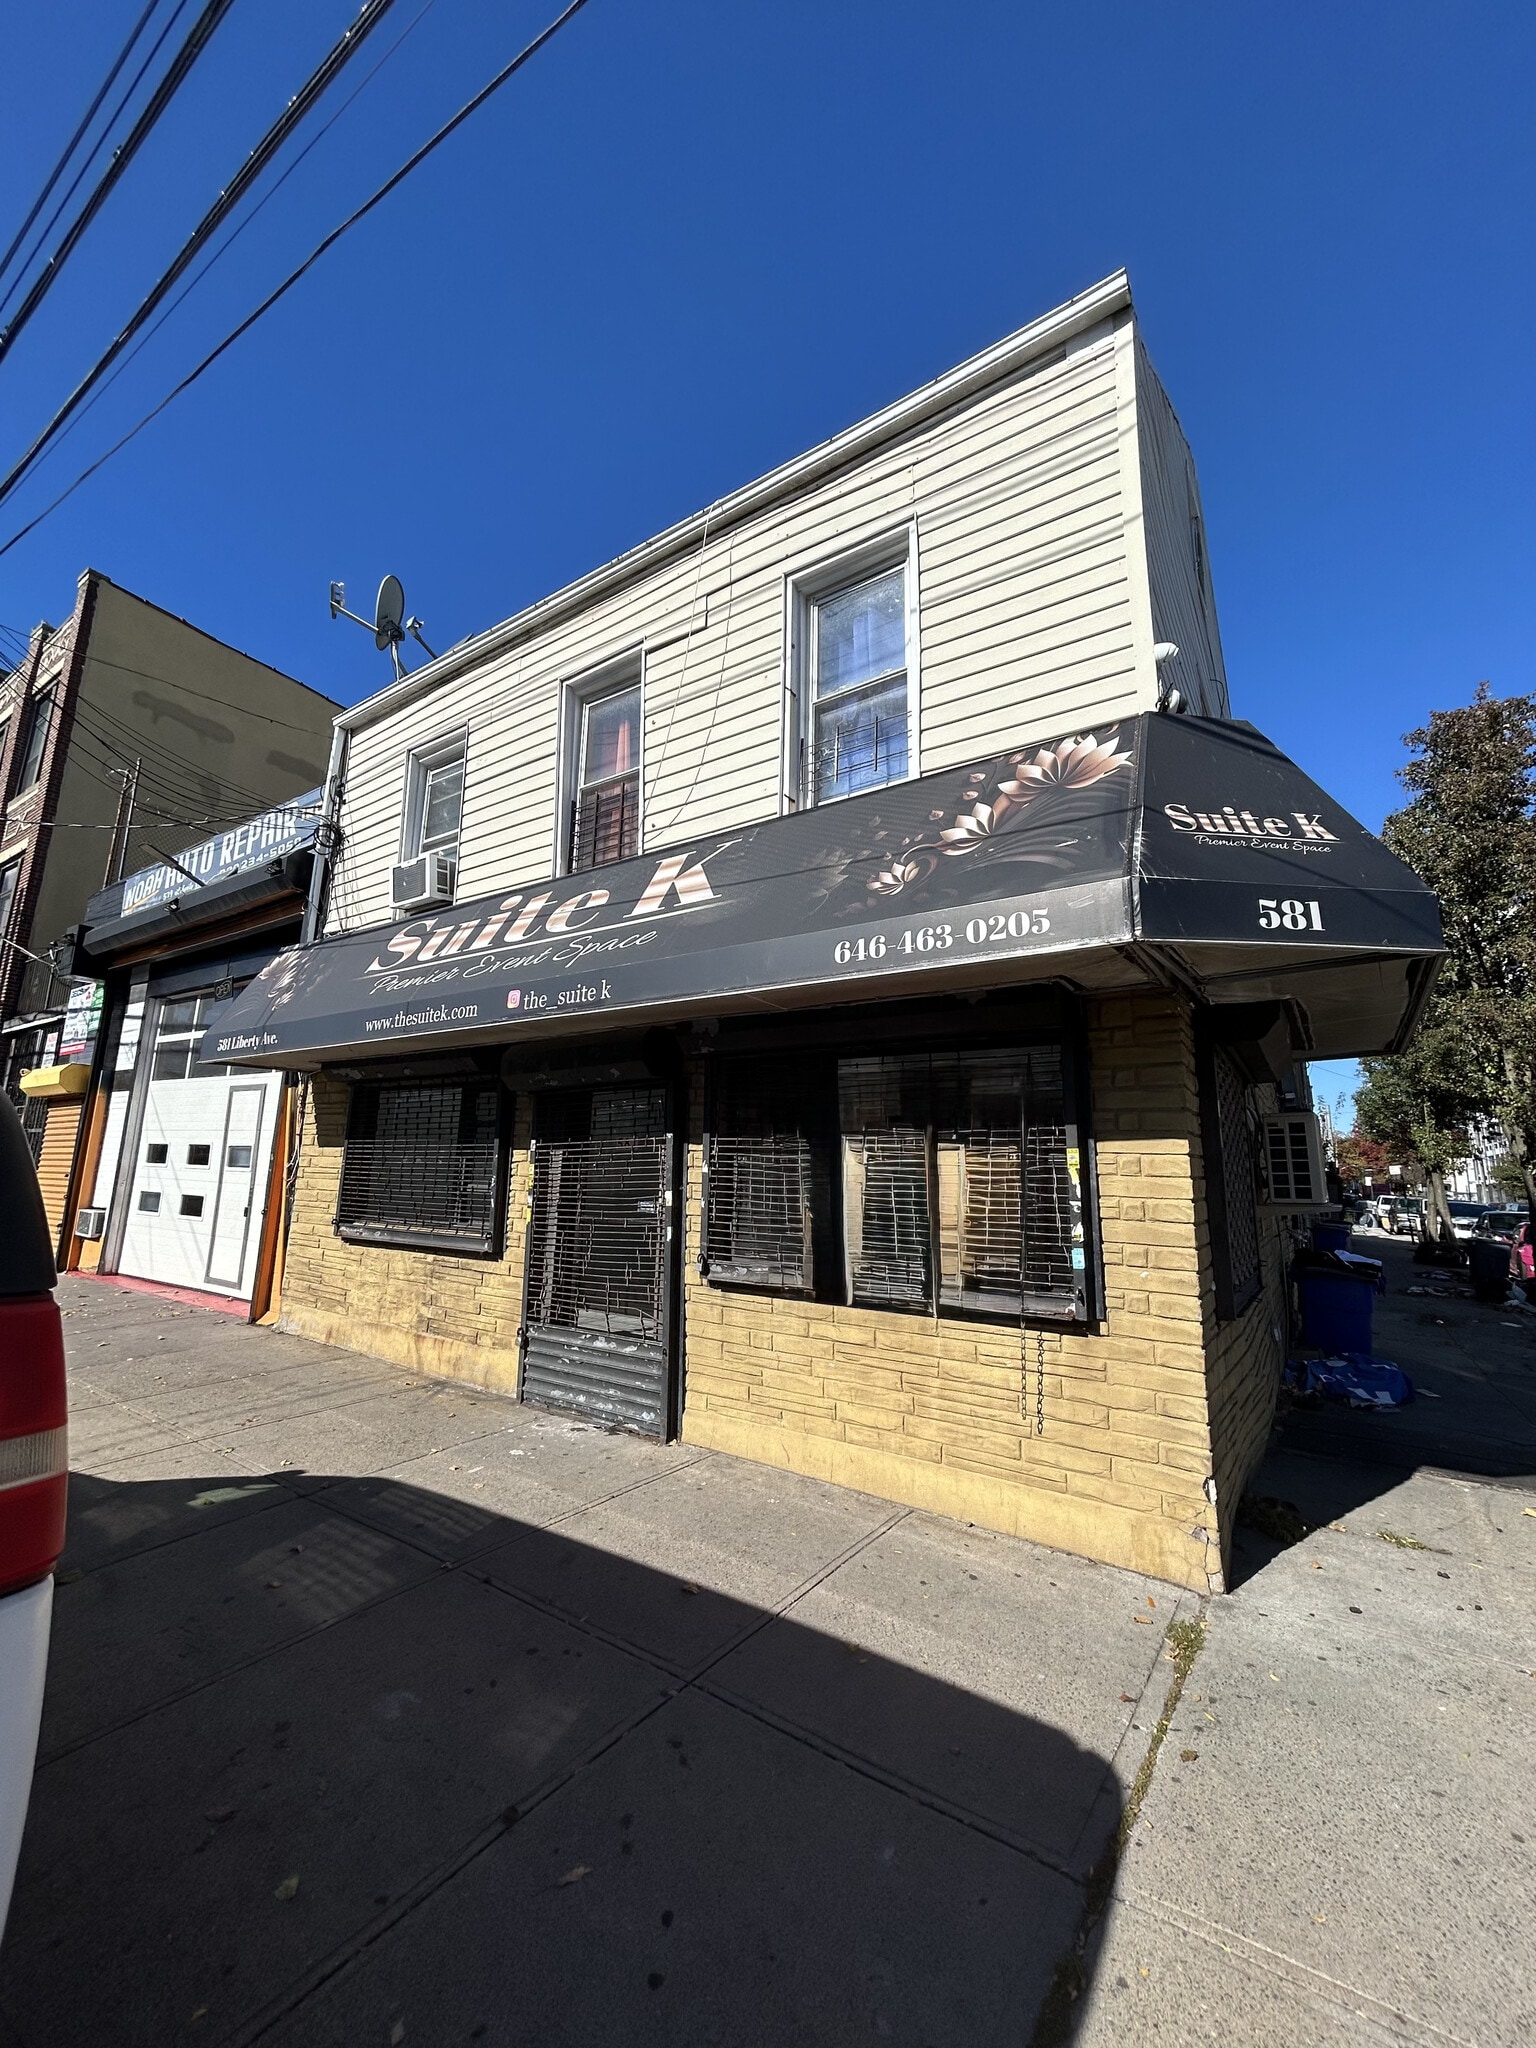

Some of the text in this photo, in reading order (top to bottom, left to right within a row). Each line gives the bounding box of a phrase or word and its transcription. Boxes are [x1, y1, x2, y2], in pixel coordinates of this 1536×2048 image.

[1164, 803, 1340, 841] Suite K
[125, 801, 299, 909] NOAH AUTO REPAIR
[1194, 834, 1332, 855] Premier Event Space
[365, 838, 743, 973] Suite K
[1258, 899, 1326, 931] 581
[834, 908, 1051, 964] 646-463-0205
[369, 930, 658, 995] Premier Event Space
[365, 1003, 478, 1032] www.thesuitek.com
[217, 1031, 278, 1052] 581 Liberty Ave.
